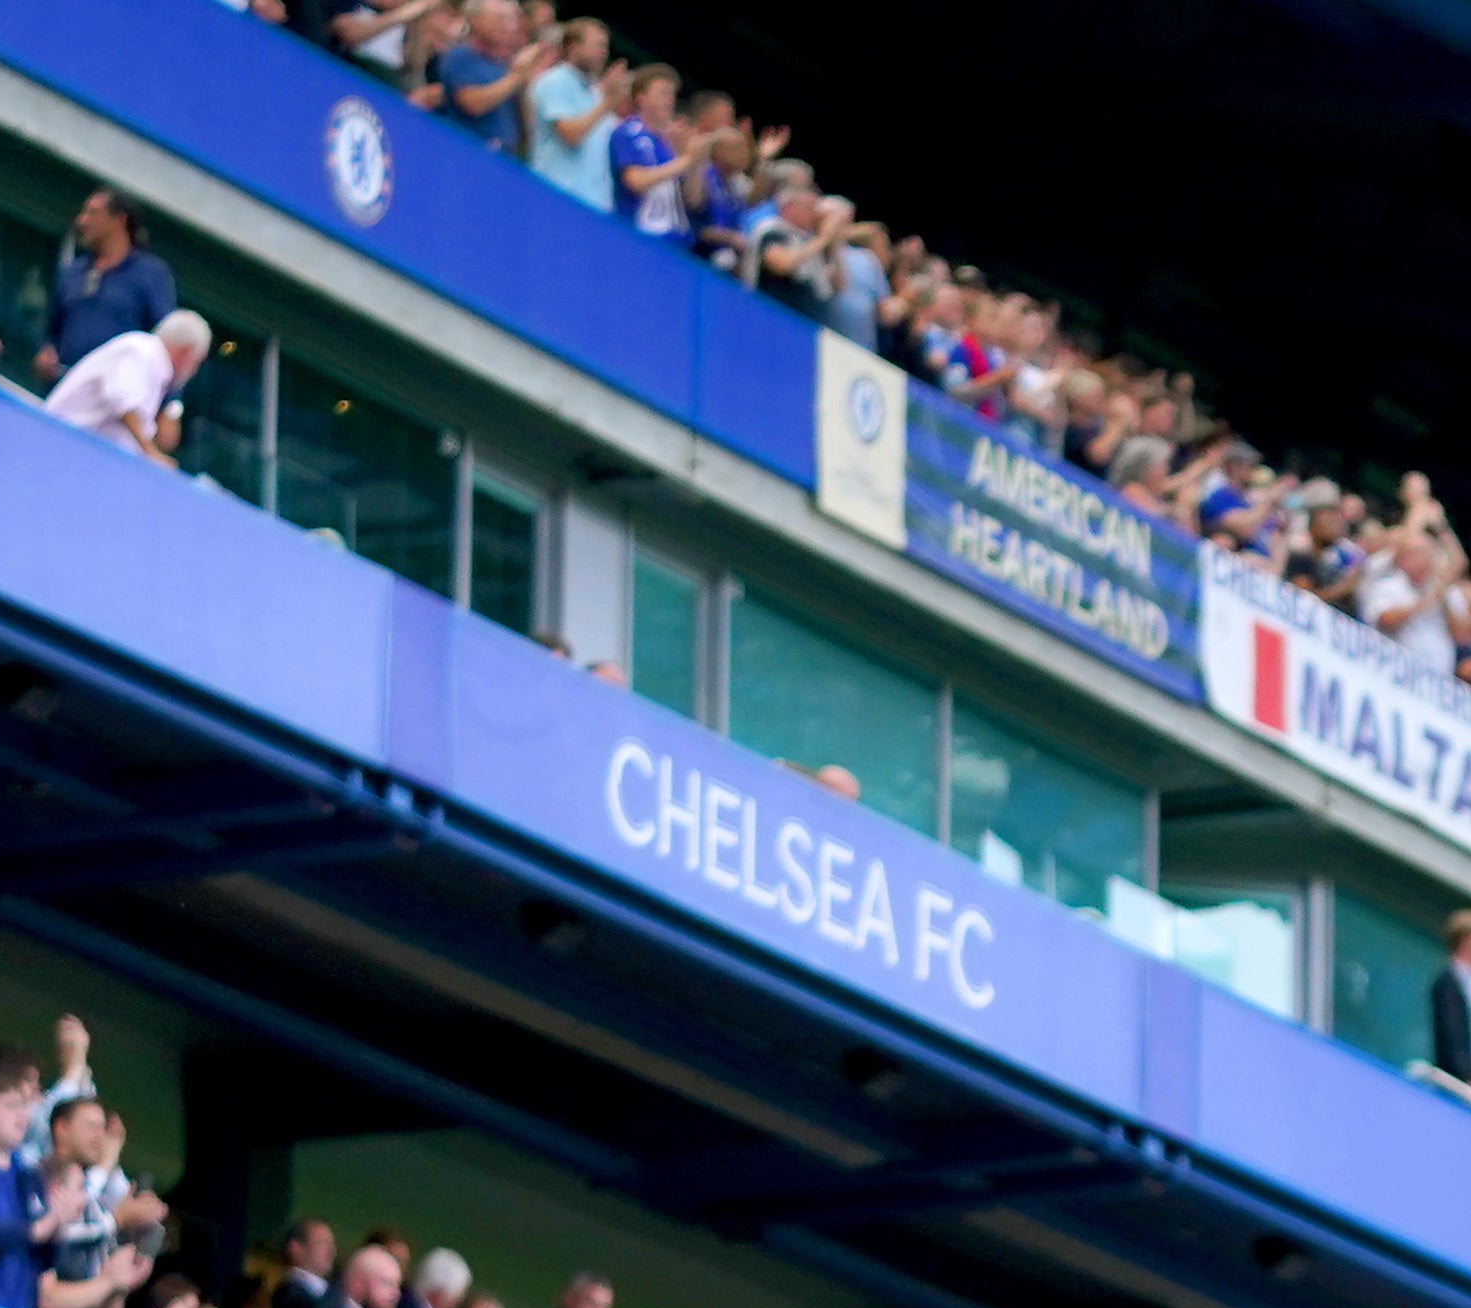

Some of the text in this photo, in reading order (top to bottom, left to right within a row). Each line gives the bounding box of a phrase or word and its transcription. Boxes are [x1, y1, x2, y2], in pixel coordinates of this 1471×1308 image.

[948, 500, 1169, 661] HEARTLAND
[968, 436, 1152, 583] AMERICAN
[606, 736, 996, 1010] CHELSEA FC
